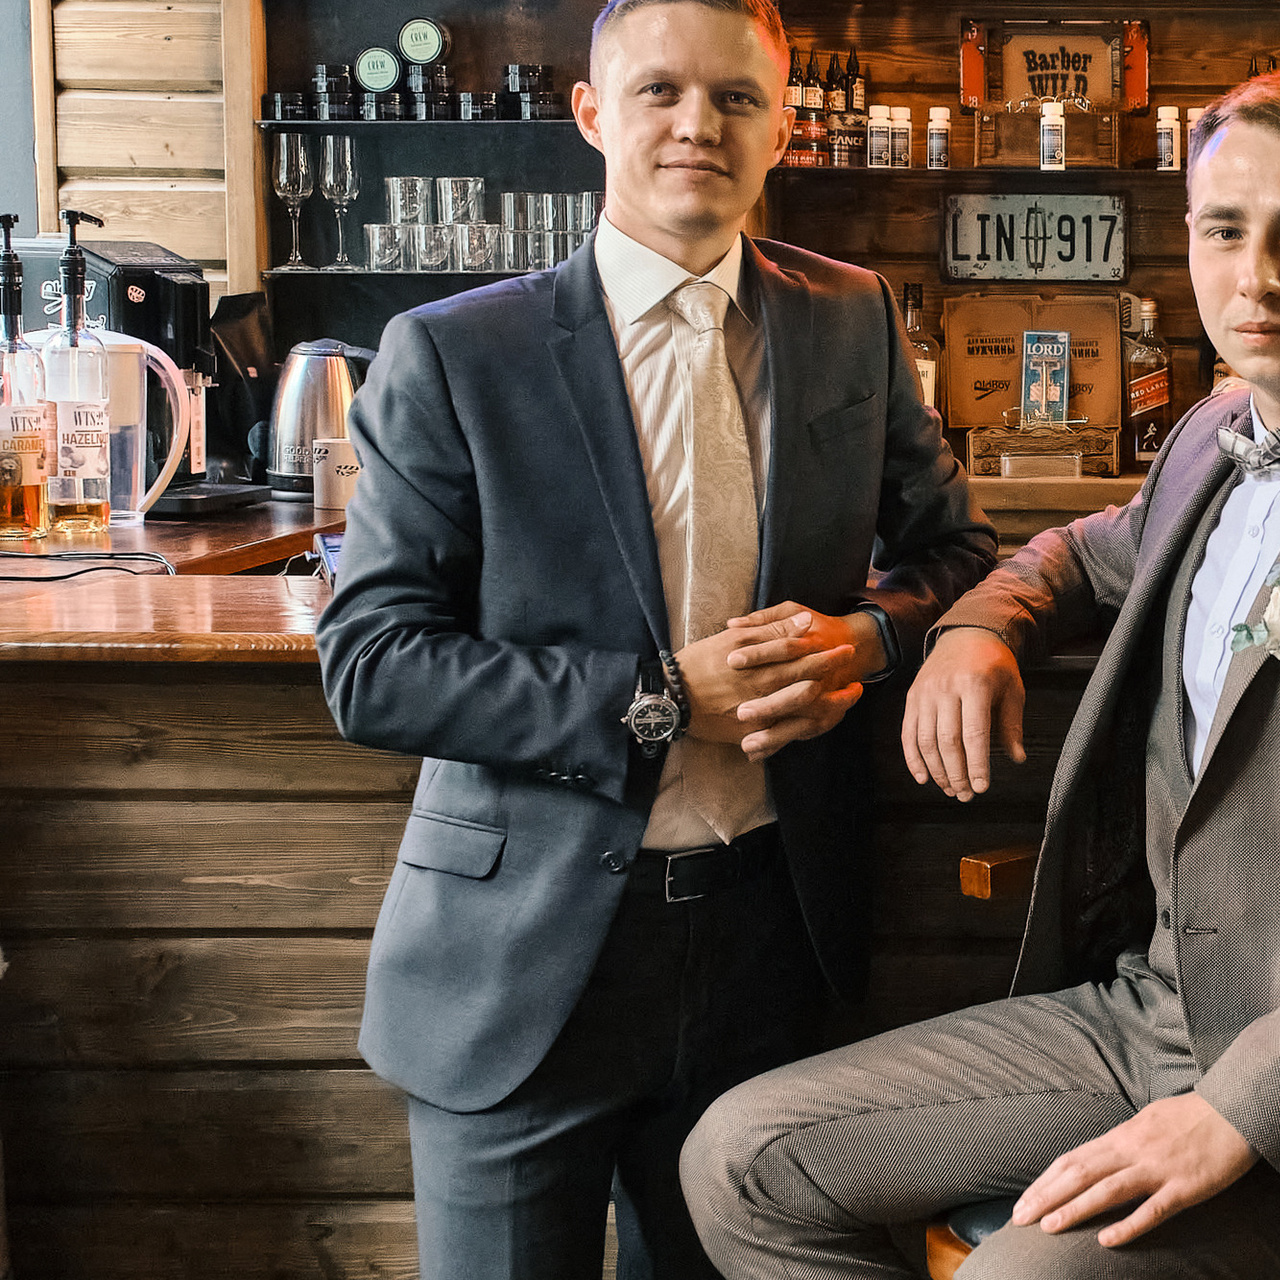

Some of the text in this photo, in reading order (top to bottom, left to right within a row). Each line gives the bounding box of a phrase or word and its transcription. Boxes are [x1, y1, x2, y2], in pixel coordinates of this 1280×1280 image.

[410, 31, 428, 43] CREW
[367, 60, 386, 71] CREW
[1023, 46, 1092, 73] Barber
[1028, 73, 1088, 97] WILD
[952, 214, 1118, 262] LIN 917
[967, 344, 1015, 356] МУЖЧИНЫ
[1027, 343, 1064, 356] LORD
[1070, 347, 1099, 359] ЧИНЫ
[1130, 389, 1145, 399] RED
